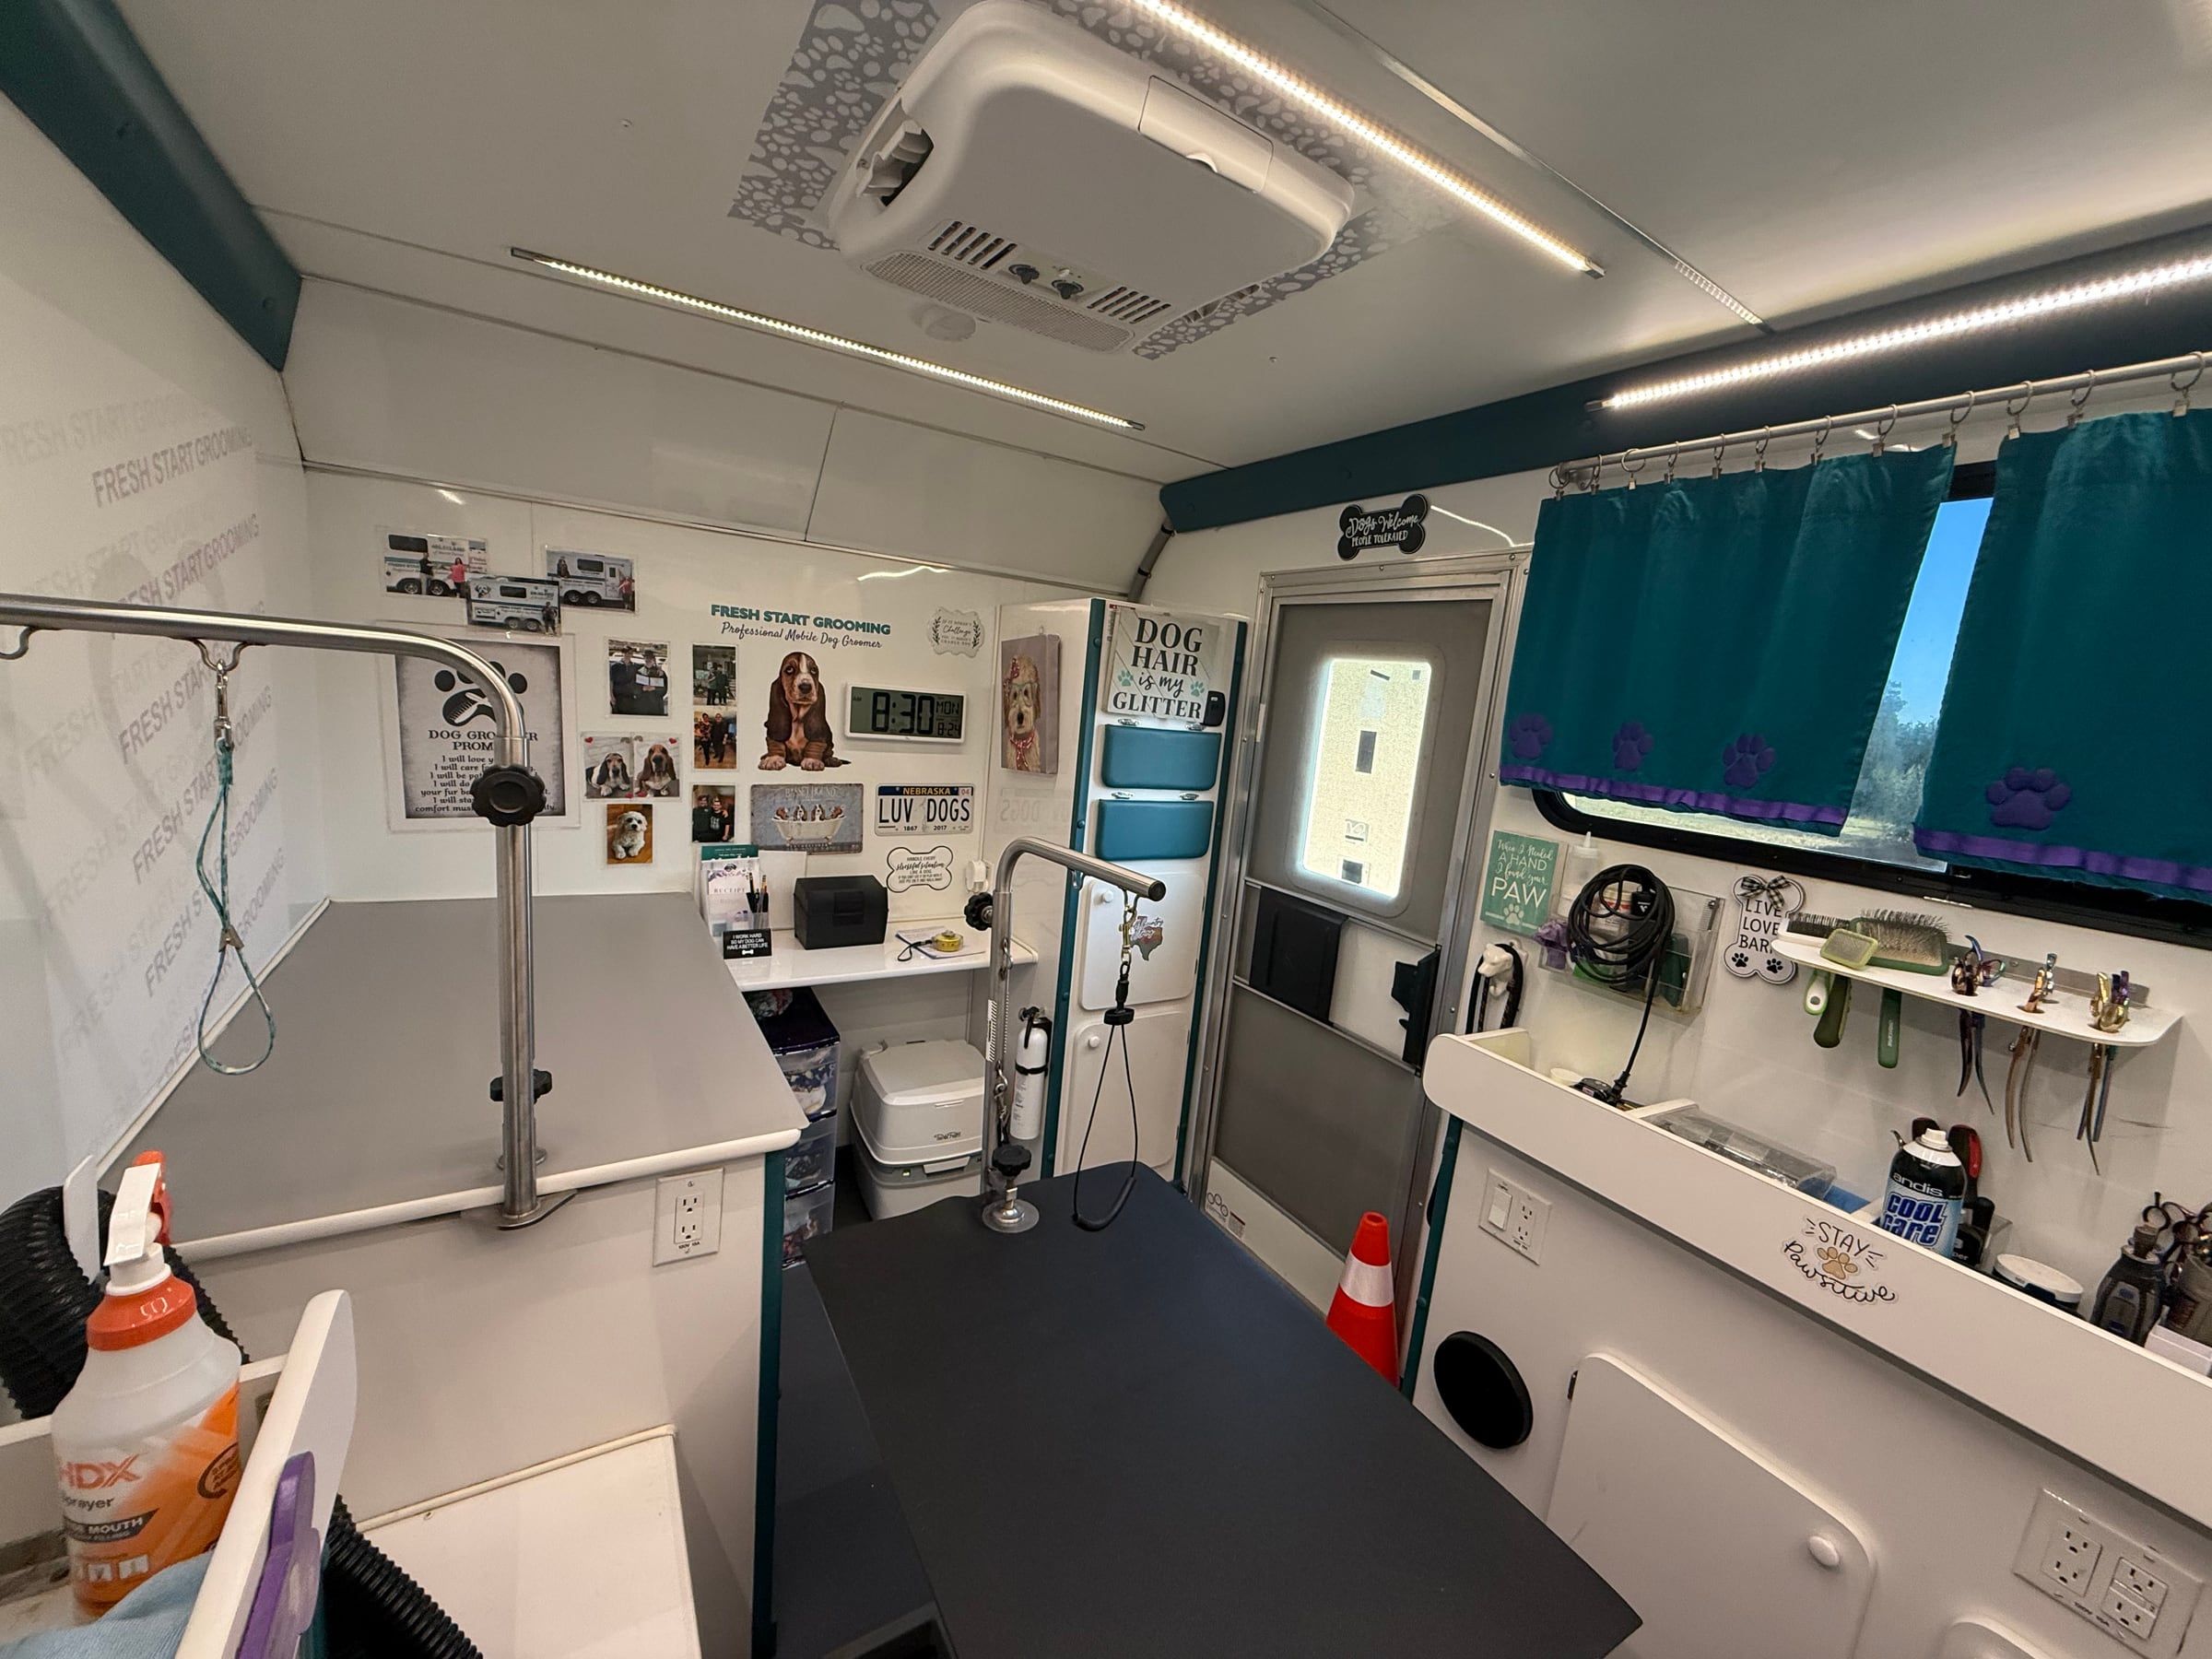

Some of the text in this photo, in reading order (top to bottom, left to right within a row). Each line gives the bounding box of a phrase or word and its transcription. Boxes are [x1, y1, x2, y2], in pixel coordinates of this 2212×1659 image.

[90, 427, 253, 508] FRESH START GROOMING
[1346, 512, 1419, 538] Dogs Welcome
[1351, 530, 1408, 547] PEOPLE TOLERATED
[162, 549, 205, 601] START
[203, 512, 260, 571] GROOMING
[711, 604, 891, 635] FRESH START GROOMING
[722, 621, 883, 649] Professional Mobile Dog Groomer
[1135, 618, 1203, 653] DOG
[1131, 645, 1198, 677] HAIR
[1138, 672, 1184, 698] is my
[871, 691, 935, 735] 8:30
[935, 700, 959, 714] MON
[1112, 691, 1202, 719] GLITTER
[118, 684, 176, 765] FRESH
[428, 730, 461, 740] DOG
[453, 741, 494, 751] PROM
[878, 798, 971, 823] LUV DOGS
[132, 799, 184, 885] FRESH
[1498, 839, 1554, 861] When I Needed
[1495, 862, 1503, 874] I
[1526, 874, 1548, 886] your
[1498, 852, 1547, 871] A HAND
[1491, 877, 1547, 909] PAW
[1745, 899, 1782, 918] LIVE
[1743, 916, 1781, 935] LOVE
[146, 904, 192, 998] FRESH
[1738, 935, 1772, 954] BAR
[1892, 1172, 1944, 1197] andis
[1818, 1221, 1870, 1256] STAY
[1783, 1241, 1896, 1302] Pawsitive
[88, 1517, 144, 1535] MOUTH
